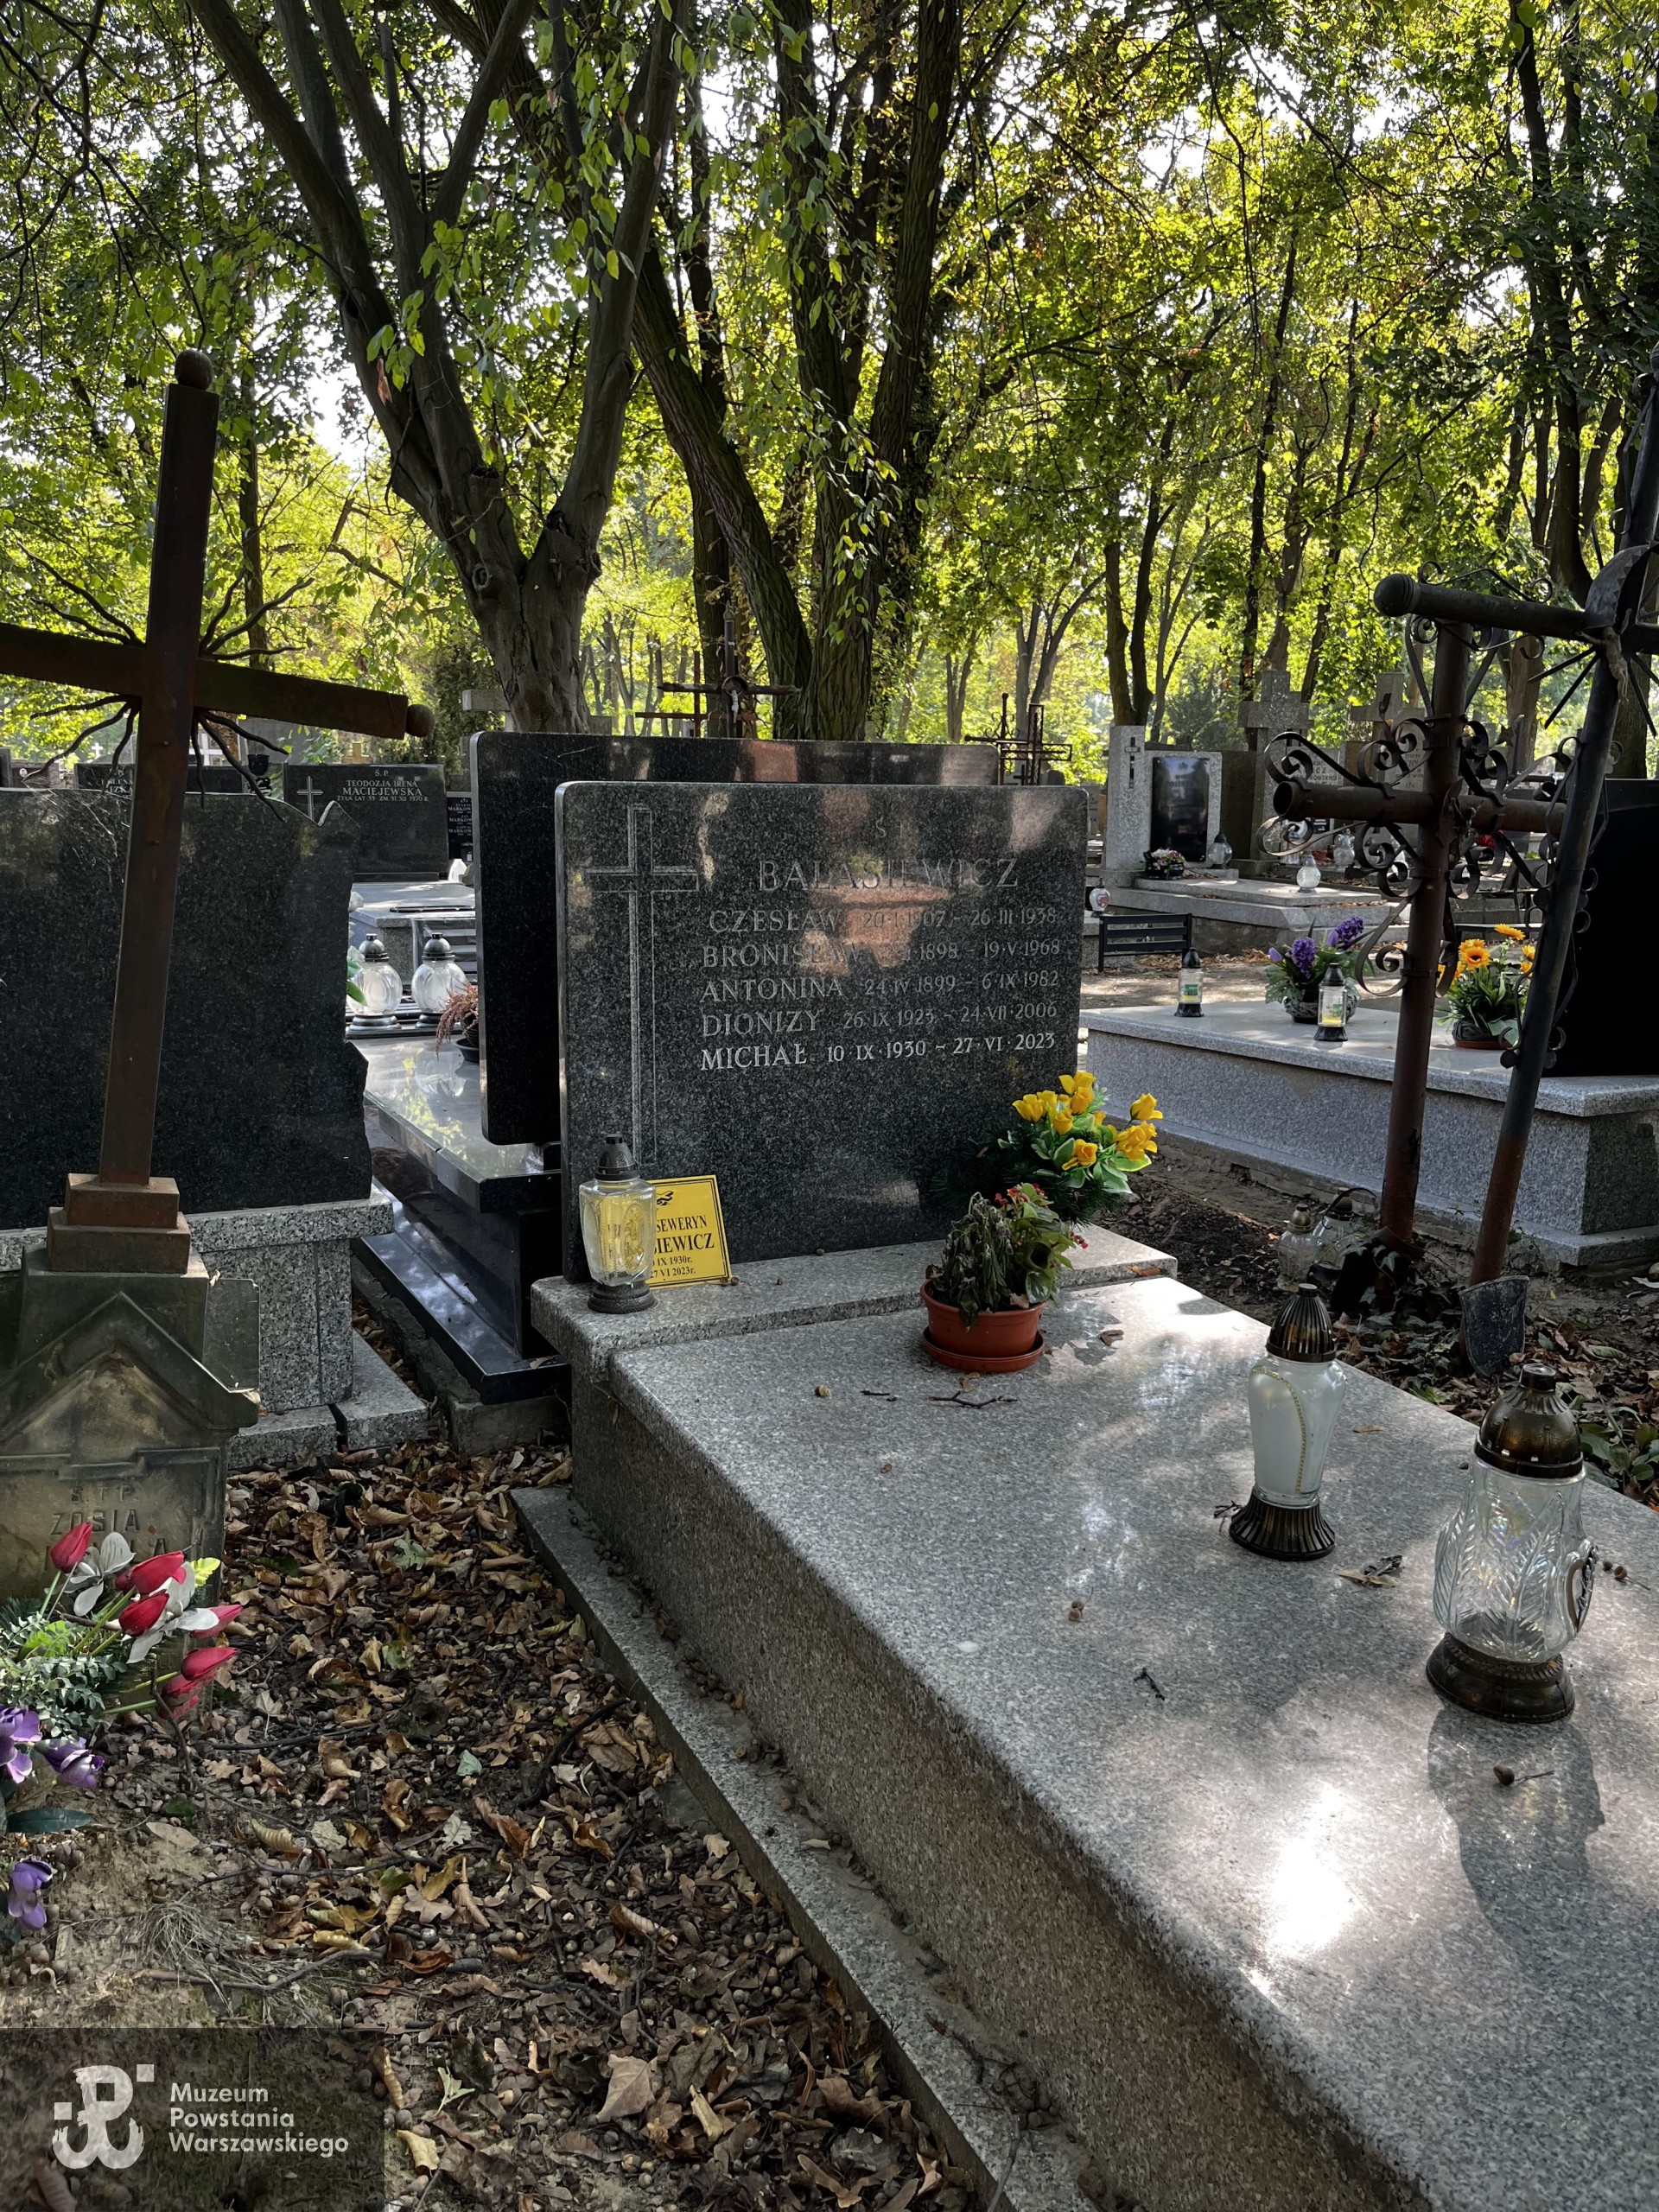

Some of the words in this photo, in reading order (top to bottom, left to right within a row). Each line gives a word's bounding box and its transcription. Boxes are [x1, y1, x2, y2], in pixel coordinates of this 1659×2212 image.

[342, 787, 423, 797] MACIEJEWSKA
[393, 779, 418, 788] IRENA
[709, 907, 841, 933] CZESŁAW
[699, 976, 845, 1003] ANTONINA
[702, 1009, 823, 1037] DIONIZY
[701, 1043, 807, 1071] MICHAŁ
[656, 1215, 708, 1233] SEWERYN
[654, 1232, 715, 1255] IEWICZ
[49, 1508, 142, 1535] ZOSIA
